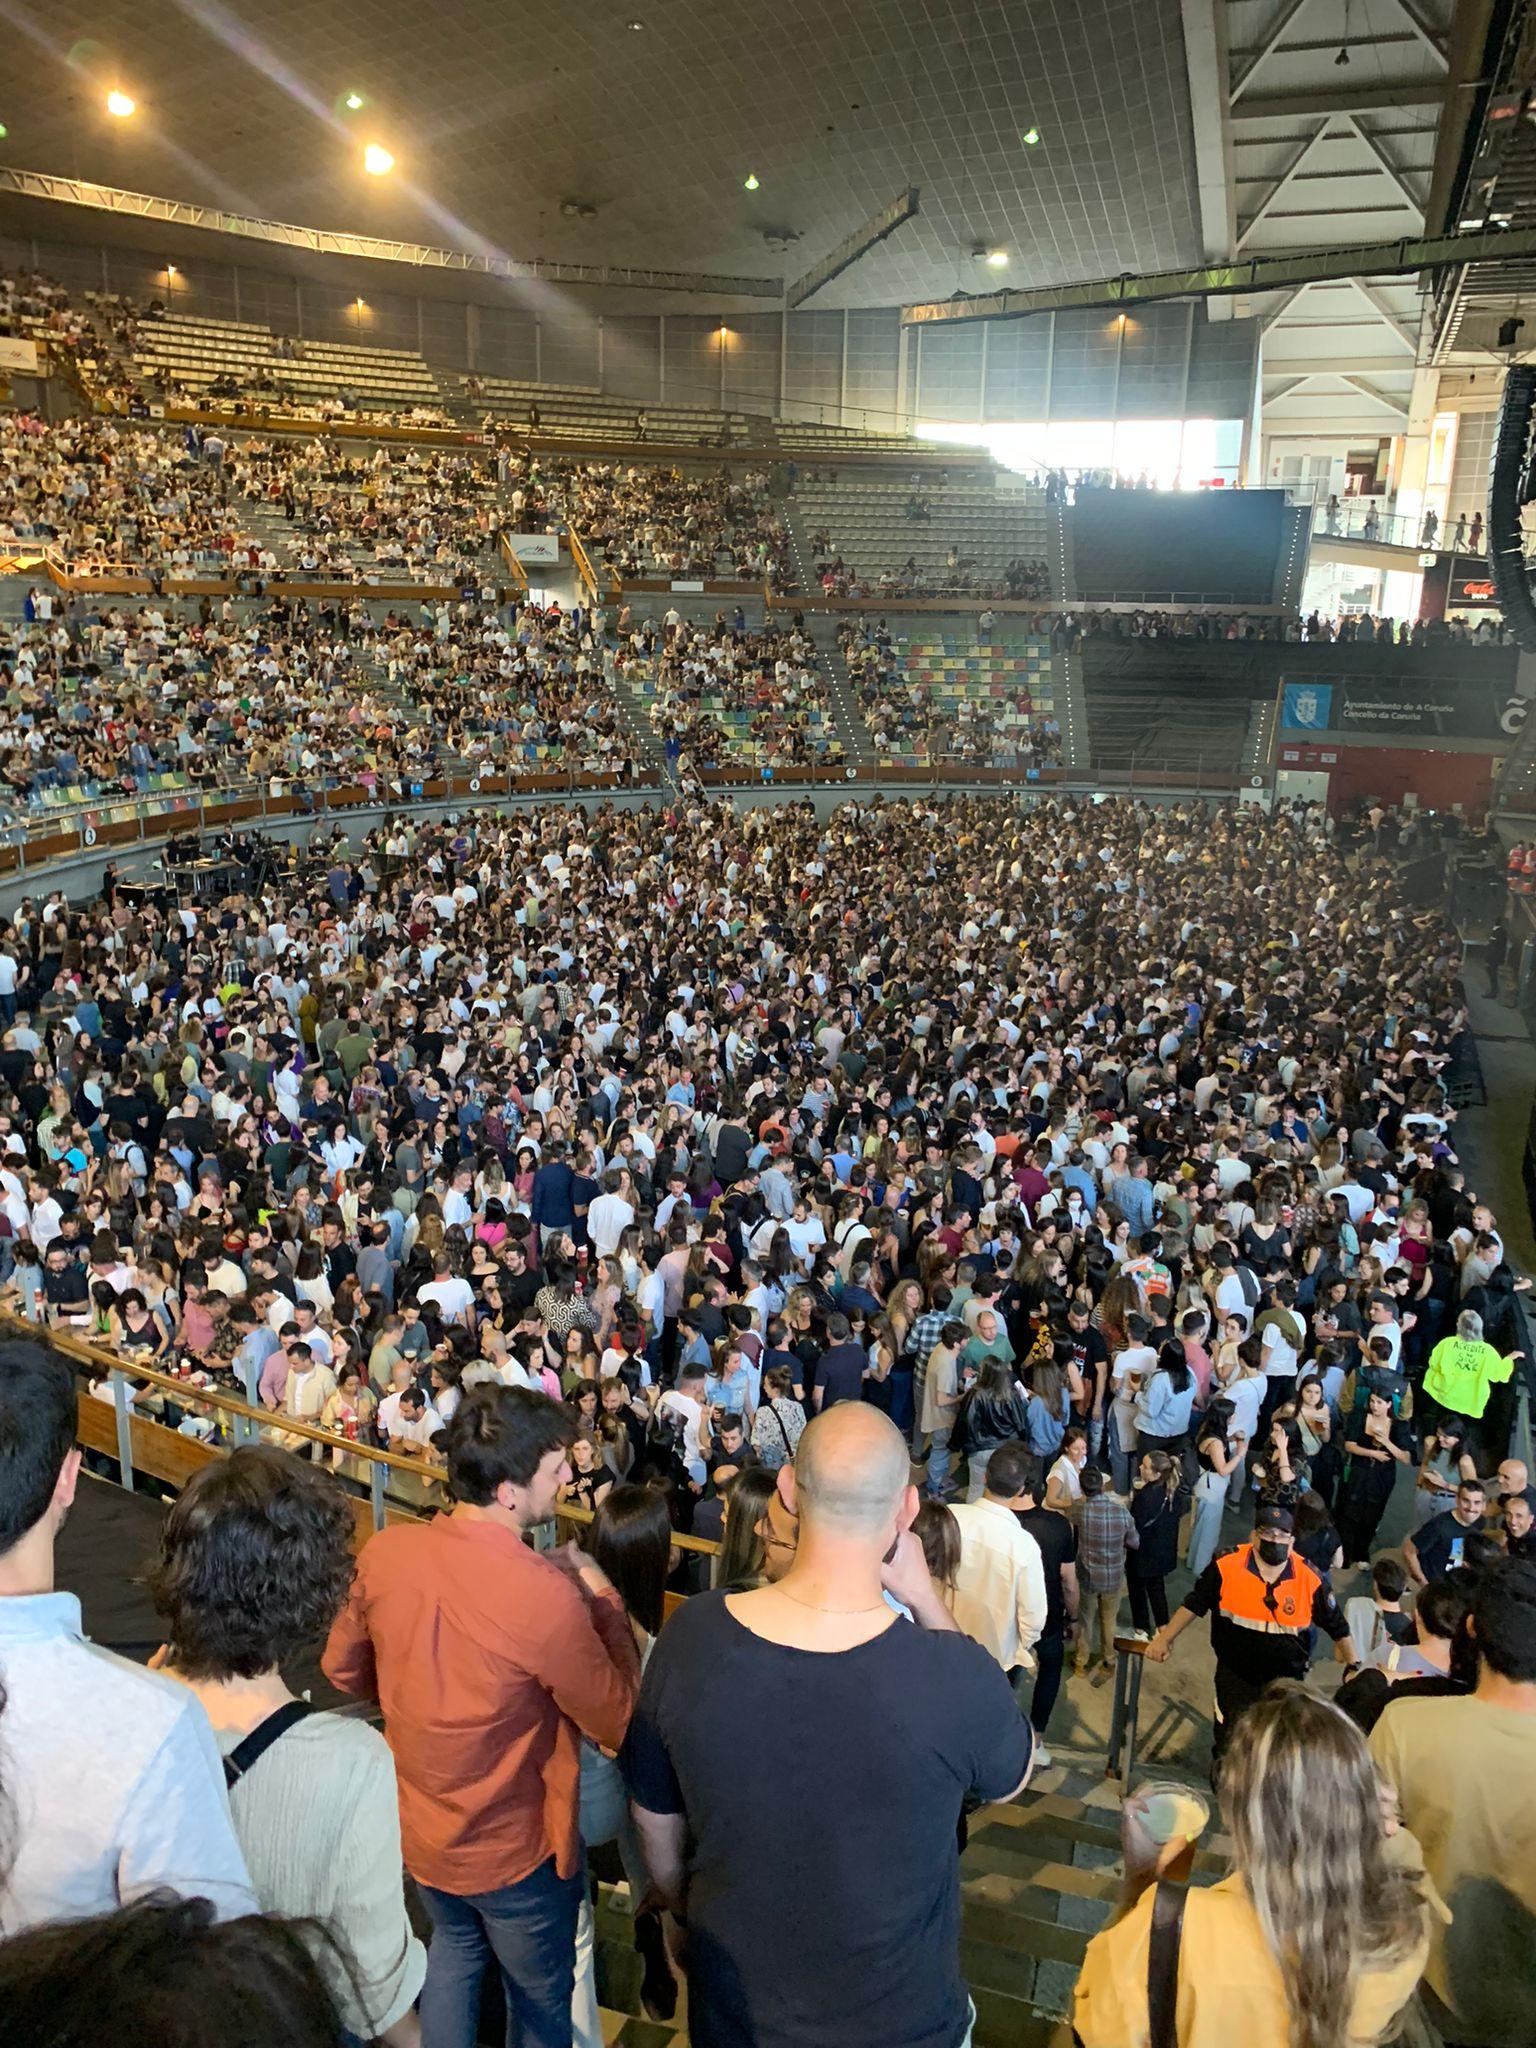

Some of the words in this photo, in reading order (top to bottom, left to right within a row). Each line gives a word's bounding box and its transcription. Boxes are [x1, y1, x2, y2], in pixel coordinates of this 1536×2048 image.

[1343, 700, 1401, 711] Ayuntamiento
[1402, 703, 1414, 711] de
[1415, 703, 1423, 711] A
[1343, 710, 1377, 719] Concello
[1378, 711, 1389, 719] da
